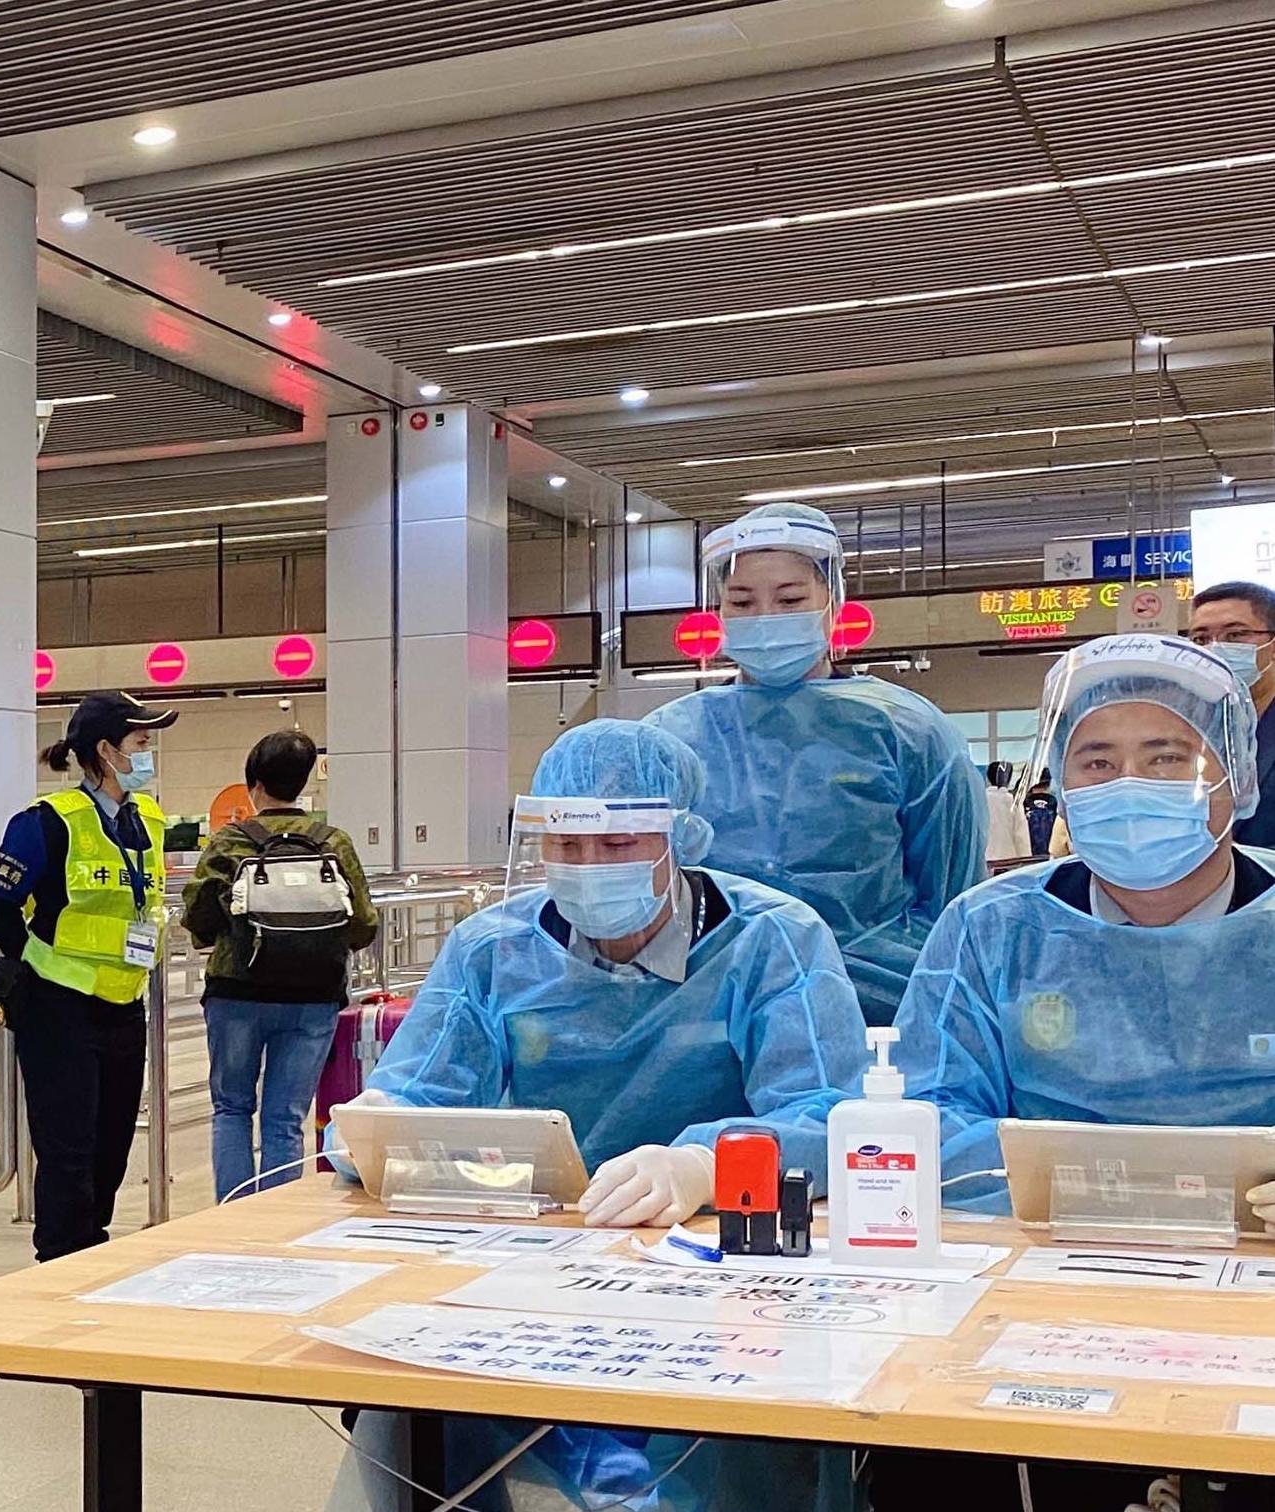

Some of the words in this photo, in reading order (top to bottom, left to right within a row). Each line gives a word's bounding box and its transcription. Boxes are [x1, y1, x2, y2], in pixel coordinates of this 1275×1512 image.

[980, 586, 1093, 613] 訪澳旅客
[998, 611, 1076, 625] VISITANTES
[1005, 624, 1067, 638] VISITORS
